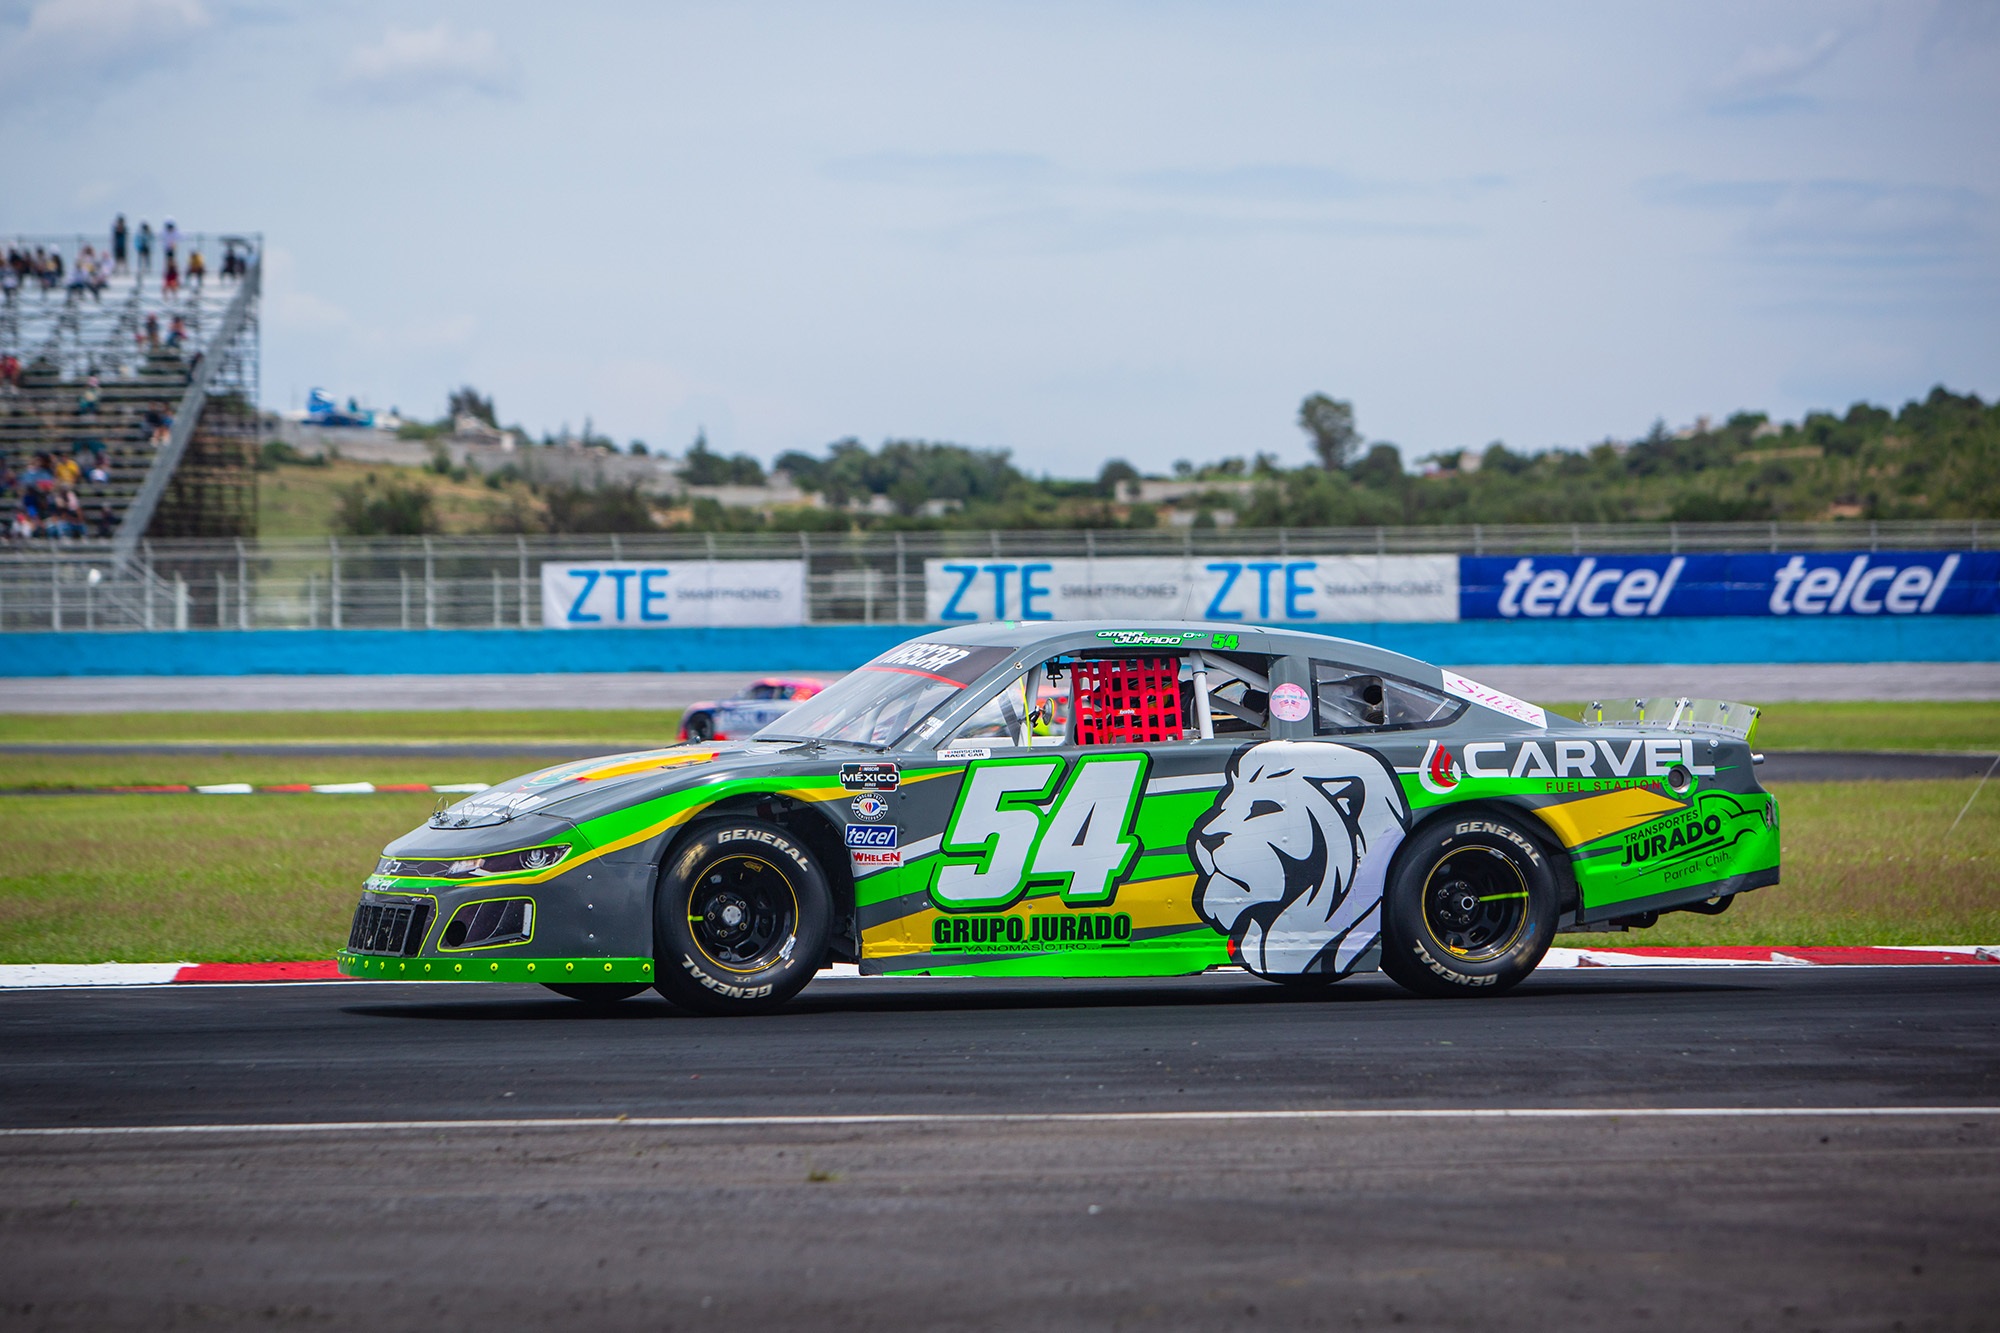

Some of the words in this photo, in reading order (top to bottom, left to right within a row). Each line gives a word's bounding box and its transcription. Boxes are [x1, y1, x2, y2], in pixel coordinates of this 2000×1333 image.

[567, 569, 669, 622] ZTE
[677, 587, 781, 600] SMARTPHONES
[941, 564, 1053, 620] ZTE
[1061, 584, 1177, 599] SMARTPHONES
[1205, 562, 1317, 619] ZTE
[1326, 582, 1443, 596] SMARTPHONES
[1497, 556, 1686, 617] telcel
[1769, 553, 1961, 616] telcel
[879, 643, 970, 672] NASCAR
[1114, 636, 1181, 645] JURADO
[1211, 633, 1239, 650] 54
[842, 772, 898, 782] MÉXICO
[1463, 739, 1715, 778] CARVEL
[1545, 781, 1582, 793] FUEL
[1593, 779, 1661, 792] STATION
[847, 827, 894, 845] telcel
[934, 756, 1145, 904] 54
[1455, 821, 1541, 868] GENERAL
[1621, 815, 1721, 867] JURADO
[1624, 809, 1698, 845] TRANSPORTES
[717, 829, 809, 873] GENERAL
[852, 851, 901, 862] WHELEN
[1664, 861, 1702, 883] Parral,
[1705, 851, 1732, 868] Chih.
[934, 917, 1023, 943] GRUPO
[1030, 915, 1131, 941] JURADO
[965, 944, 989, 953] YA
[990, 944, 1040, 952] NOMAS
[681, 953, 773, 999] GENERAL
[1413, 939, 1498, 987] GENERAL
